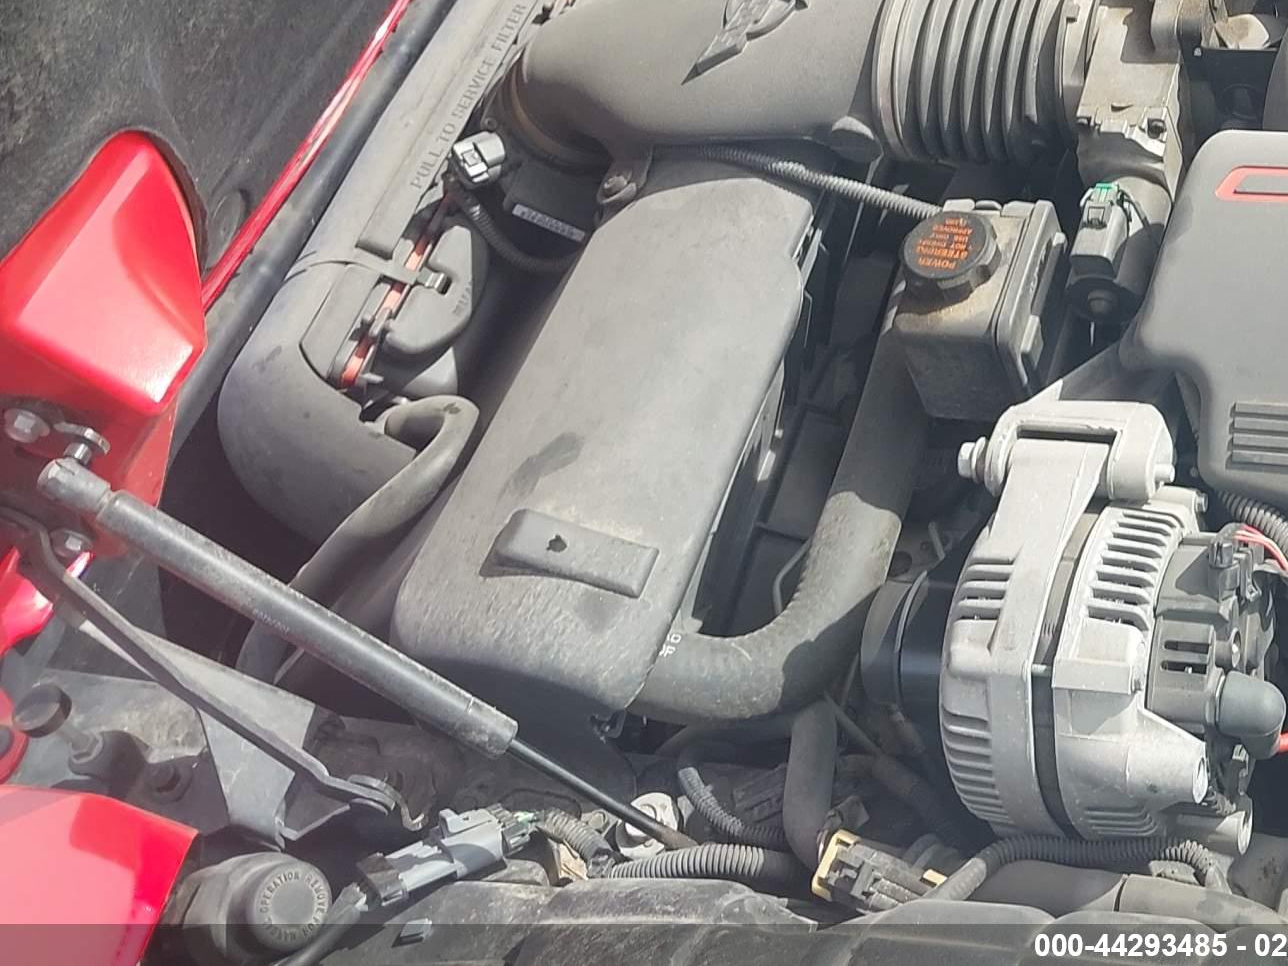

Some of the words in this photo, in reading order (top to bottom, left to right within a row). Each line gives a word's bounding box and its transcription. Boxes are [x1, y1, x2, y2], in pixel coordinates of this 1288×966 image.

[410, 150, 442, 188] PULL
[435, 122, 456, 143] TO
[451, 57, 495, 119] SERVICE
[491, 3, 527, 51] FILTER
[259, 871, 300, 914] OPERATION
